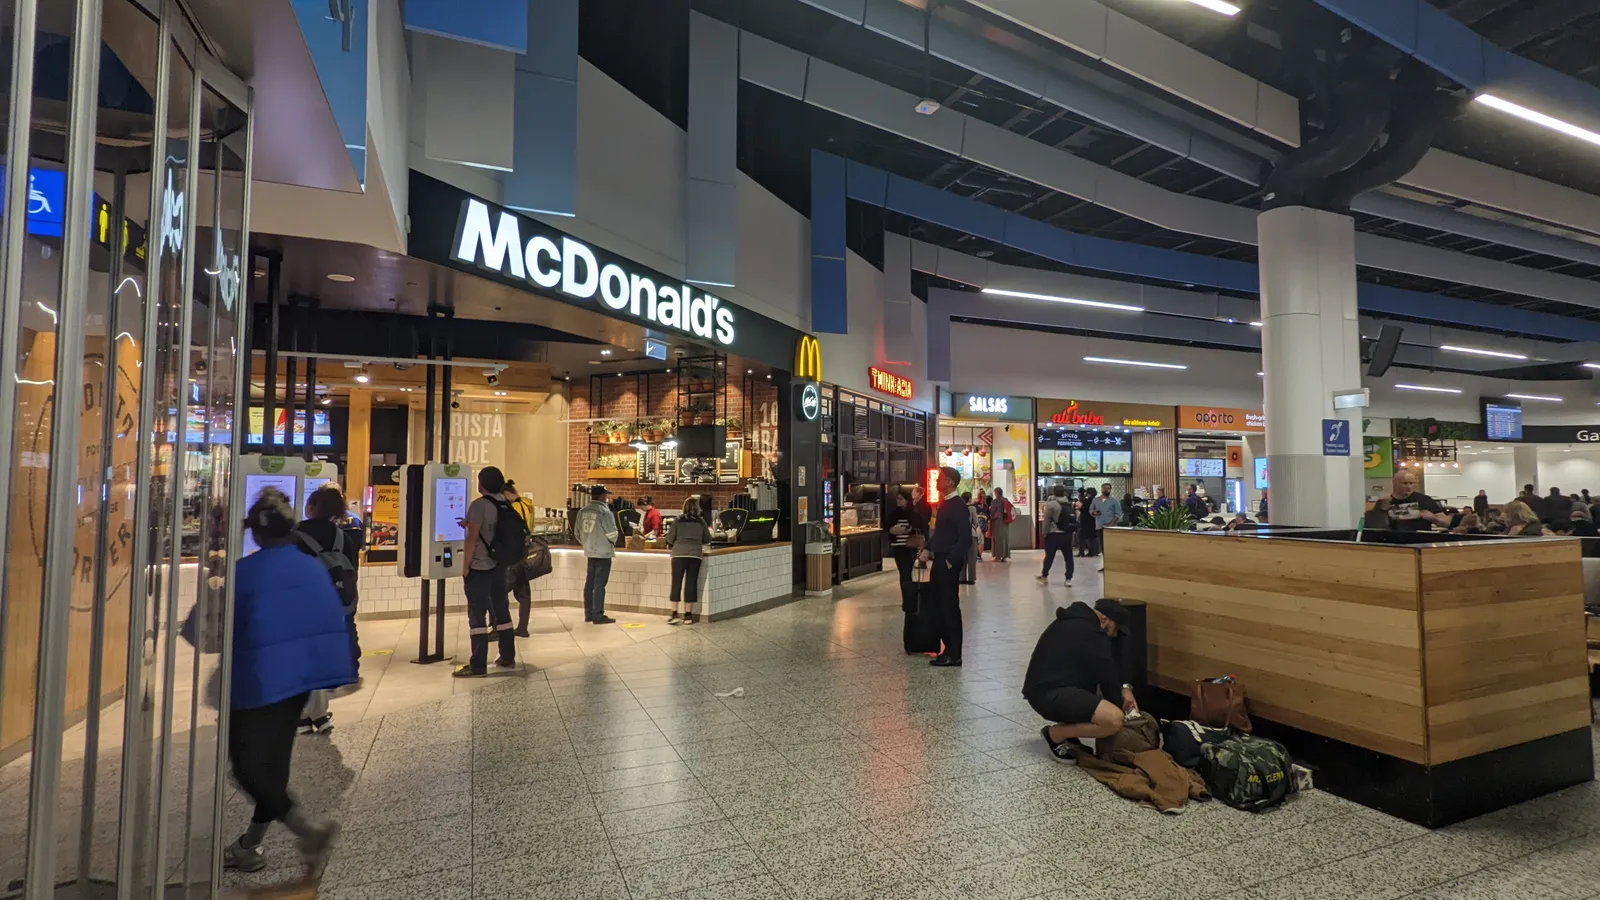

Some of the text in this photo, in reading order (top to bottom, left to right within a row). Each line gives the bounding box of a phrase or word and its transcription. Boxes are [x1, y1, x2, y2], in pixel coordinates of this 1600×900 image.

[456, 197, 736, 346] McDonald's
[968, 395, 1009, 414] SALSAS
[437, 413, 503, 438] RISTA
[1071, 410, 1104, 426] baba
[1576, 430, 1600, 442] Ga
[377, 494, 400, 503] Macc
